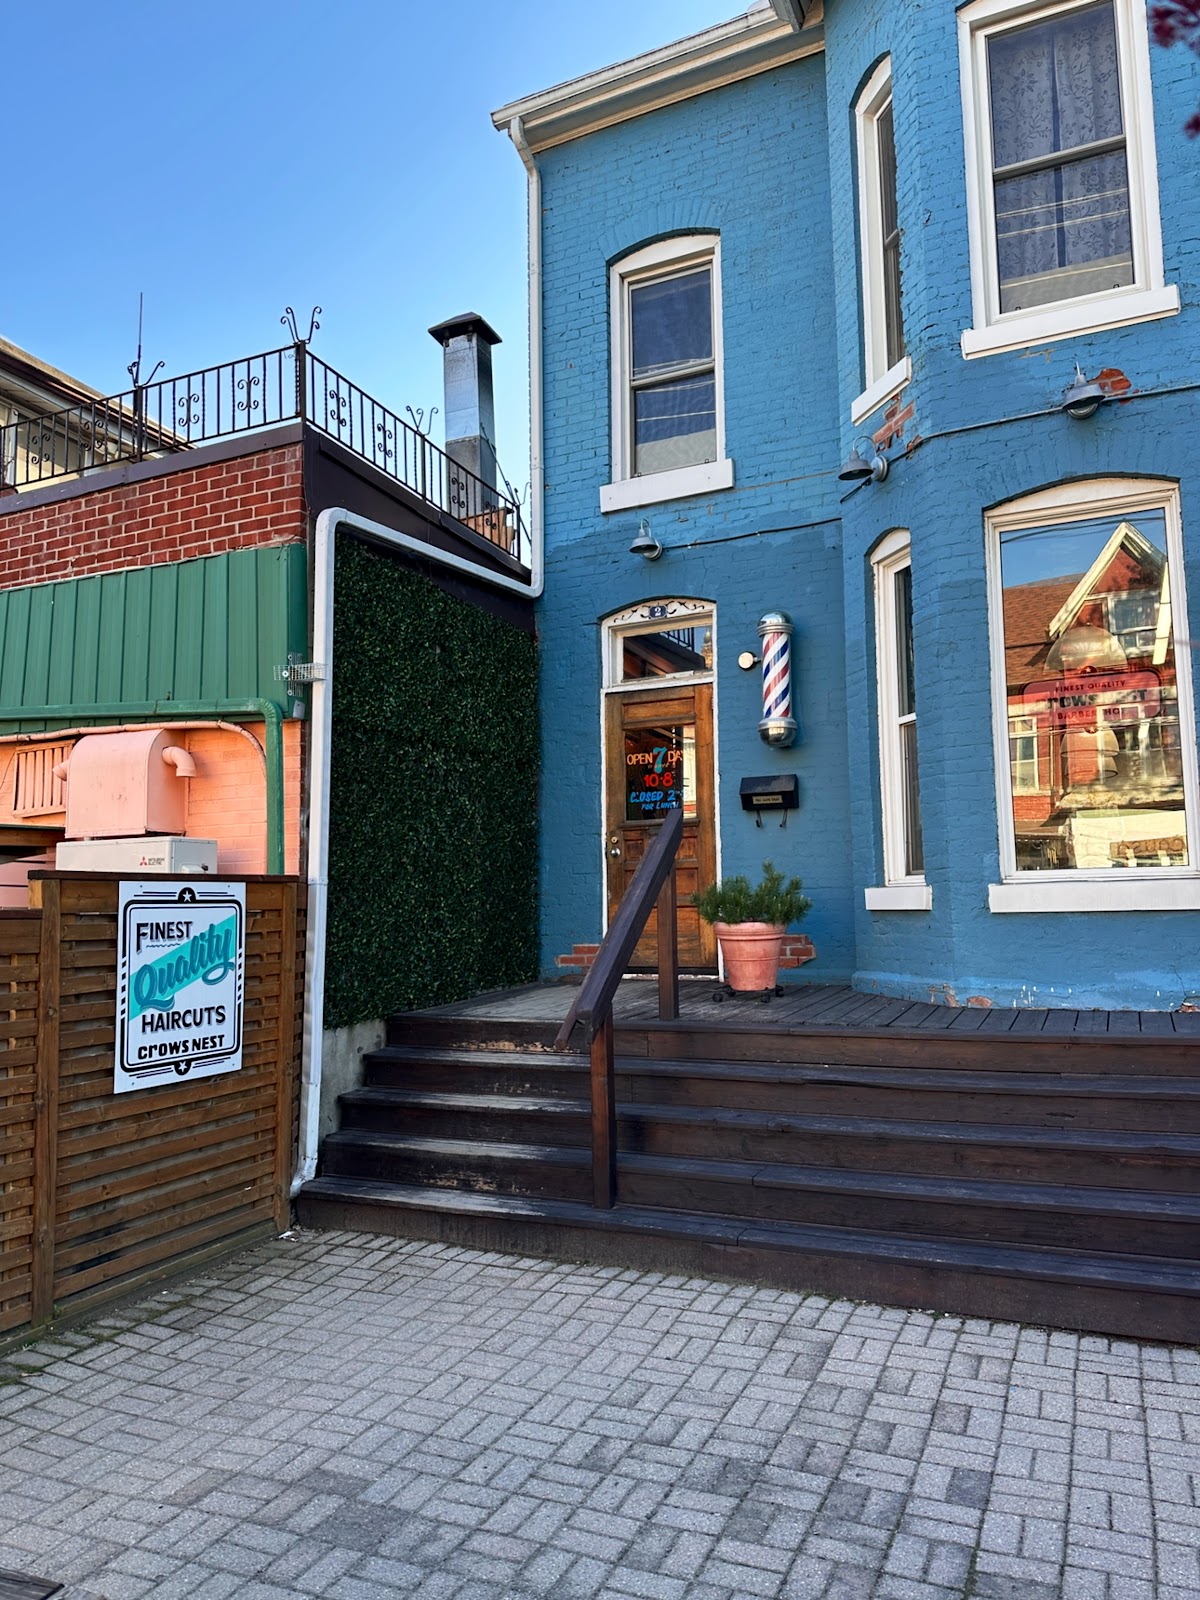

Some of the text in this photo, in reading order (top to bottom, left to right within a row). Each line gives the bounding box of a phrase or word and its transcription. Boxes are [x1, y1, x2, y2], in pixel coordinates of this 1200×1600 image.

[655, 607, 662, 616] 2
[1055, 680, 1126, 692] FINEST QUALITY
[627, 752, 653, 765] OPEN
[652, 746, 668, 774] 7
[630, 791, 664, 803] CLOSED
[666, 789, 677, 802] 2
[641, 803, 654, 811] FOR
[136, 921, 193, 955] FINEST
[134, 923, 236, 1012] Quality
[141, 1005, 227, 1034] HAIRCUTS
[192, 1034, 225, 1052] NEST
